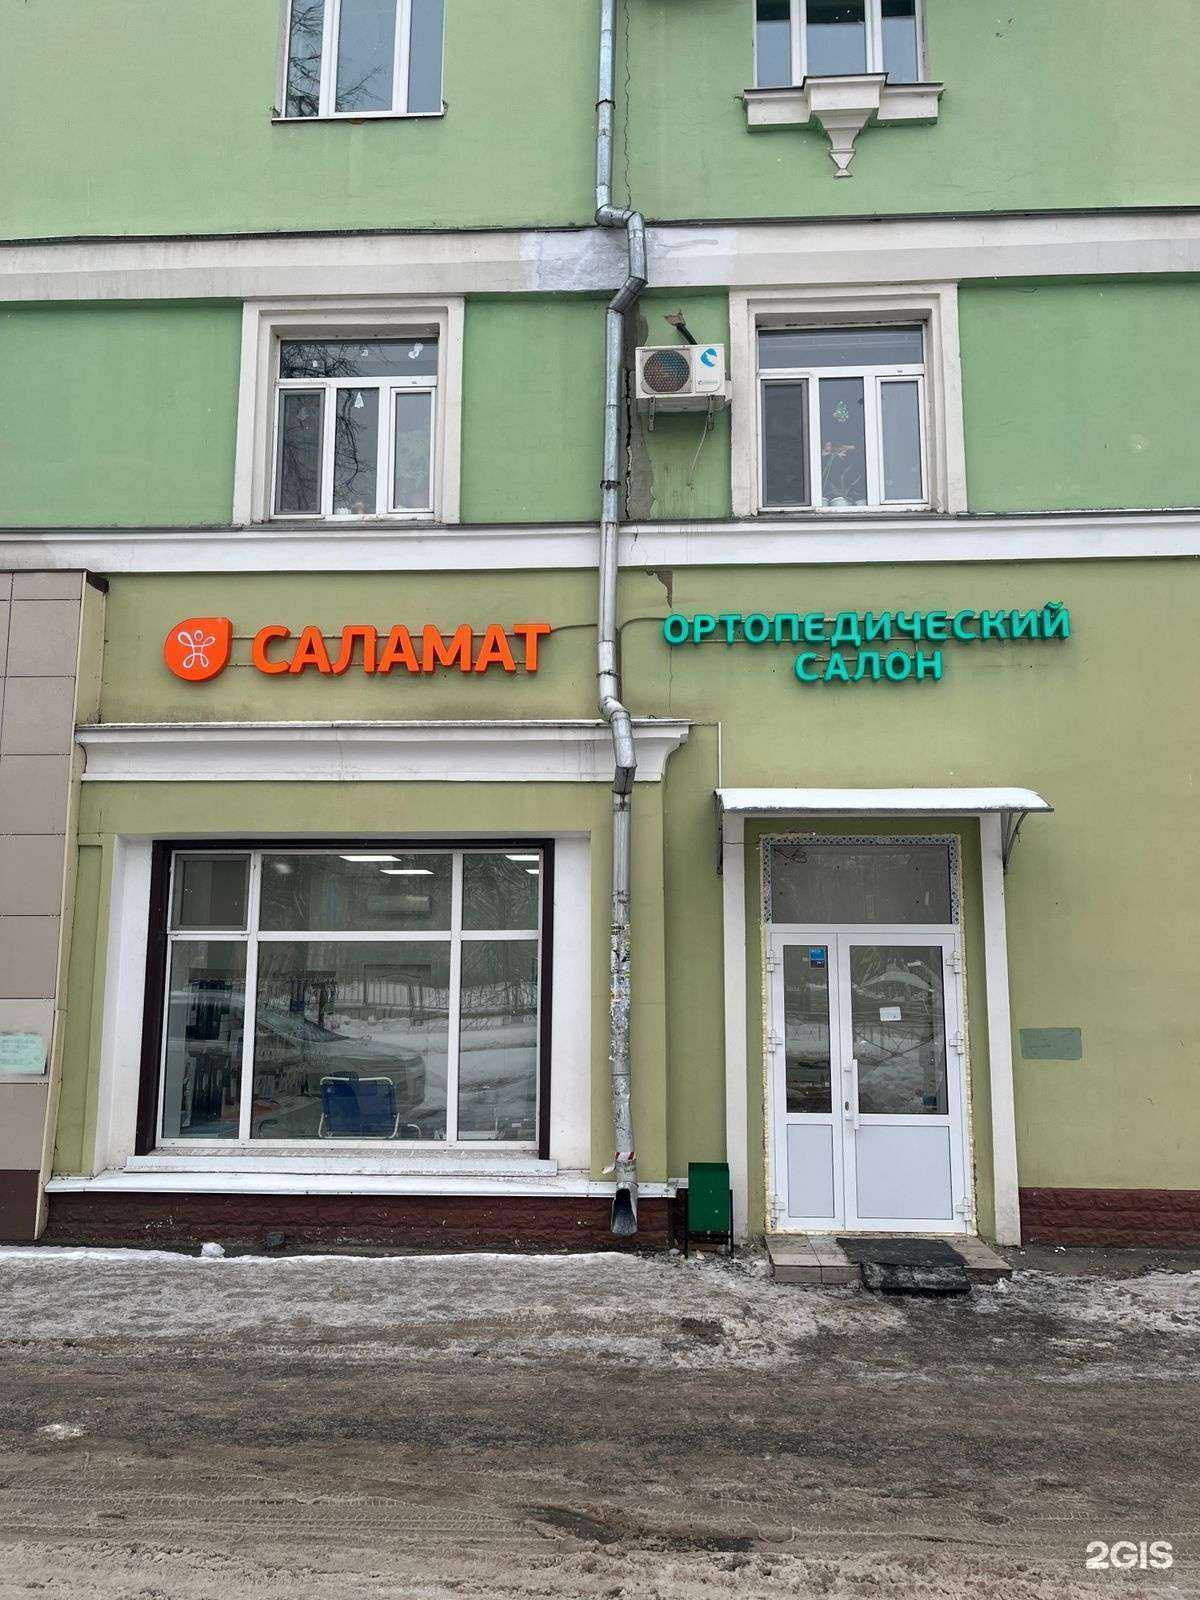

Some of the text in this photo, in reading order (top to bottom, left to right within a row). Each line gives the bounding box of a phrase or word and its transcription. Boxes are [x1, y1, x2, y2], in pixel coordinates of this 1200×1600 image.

[663, 602, 1071, 647] ОРТОПЕДИЧЕСКИЙ
[251, 623, 552, 676] САЛАМАТ
[794, 649, 944, 684] САЛОН
